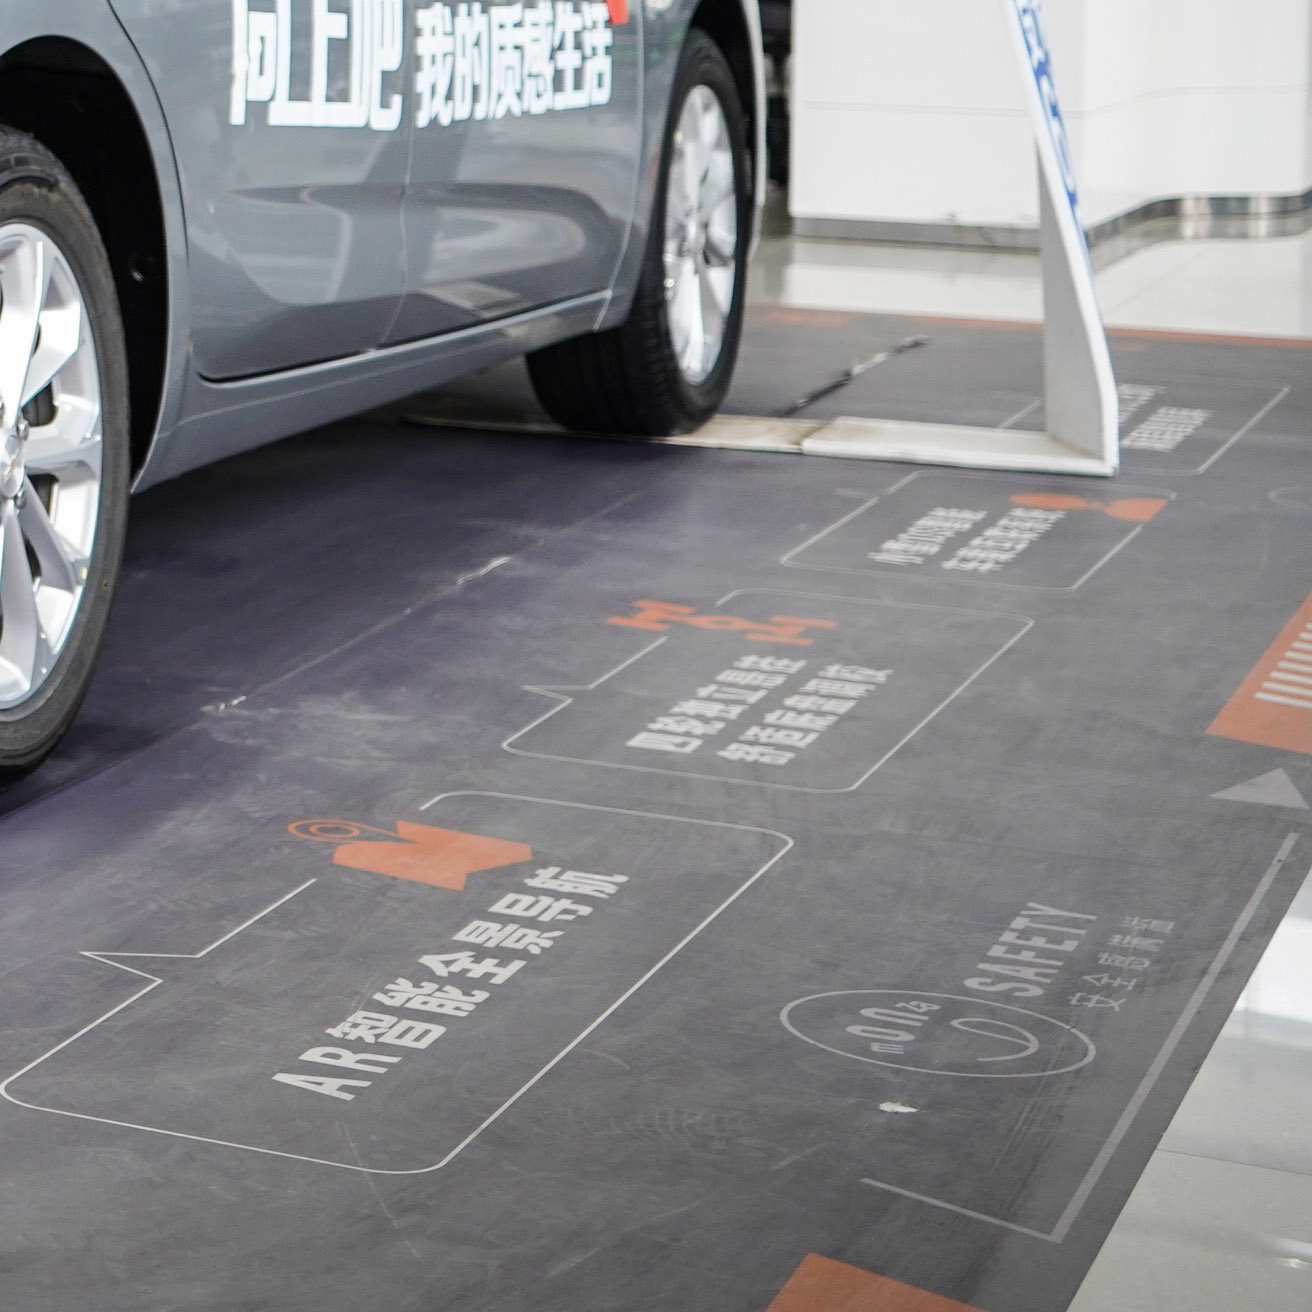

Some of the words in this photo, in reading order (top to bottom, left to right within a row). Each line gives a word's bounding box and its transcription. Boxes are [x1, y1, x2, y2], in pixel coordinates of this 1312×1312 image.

[271, 866, 631, 1101] AR智能全景导航
[964, 901, 1098, 998] SAFETY
